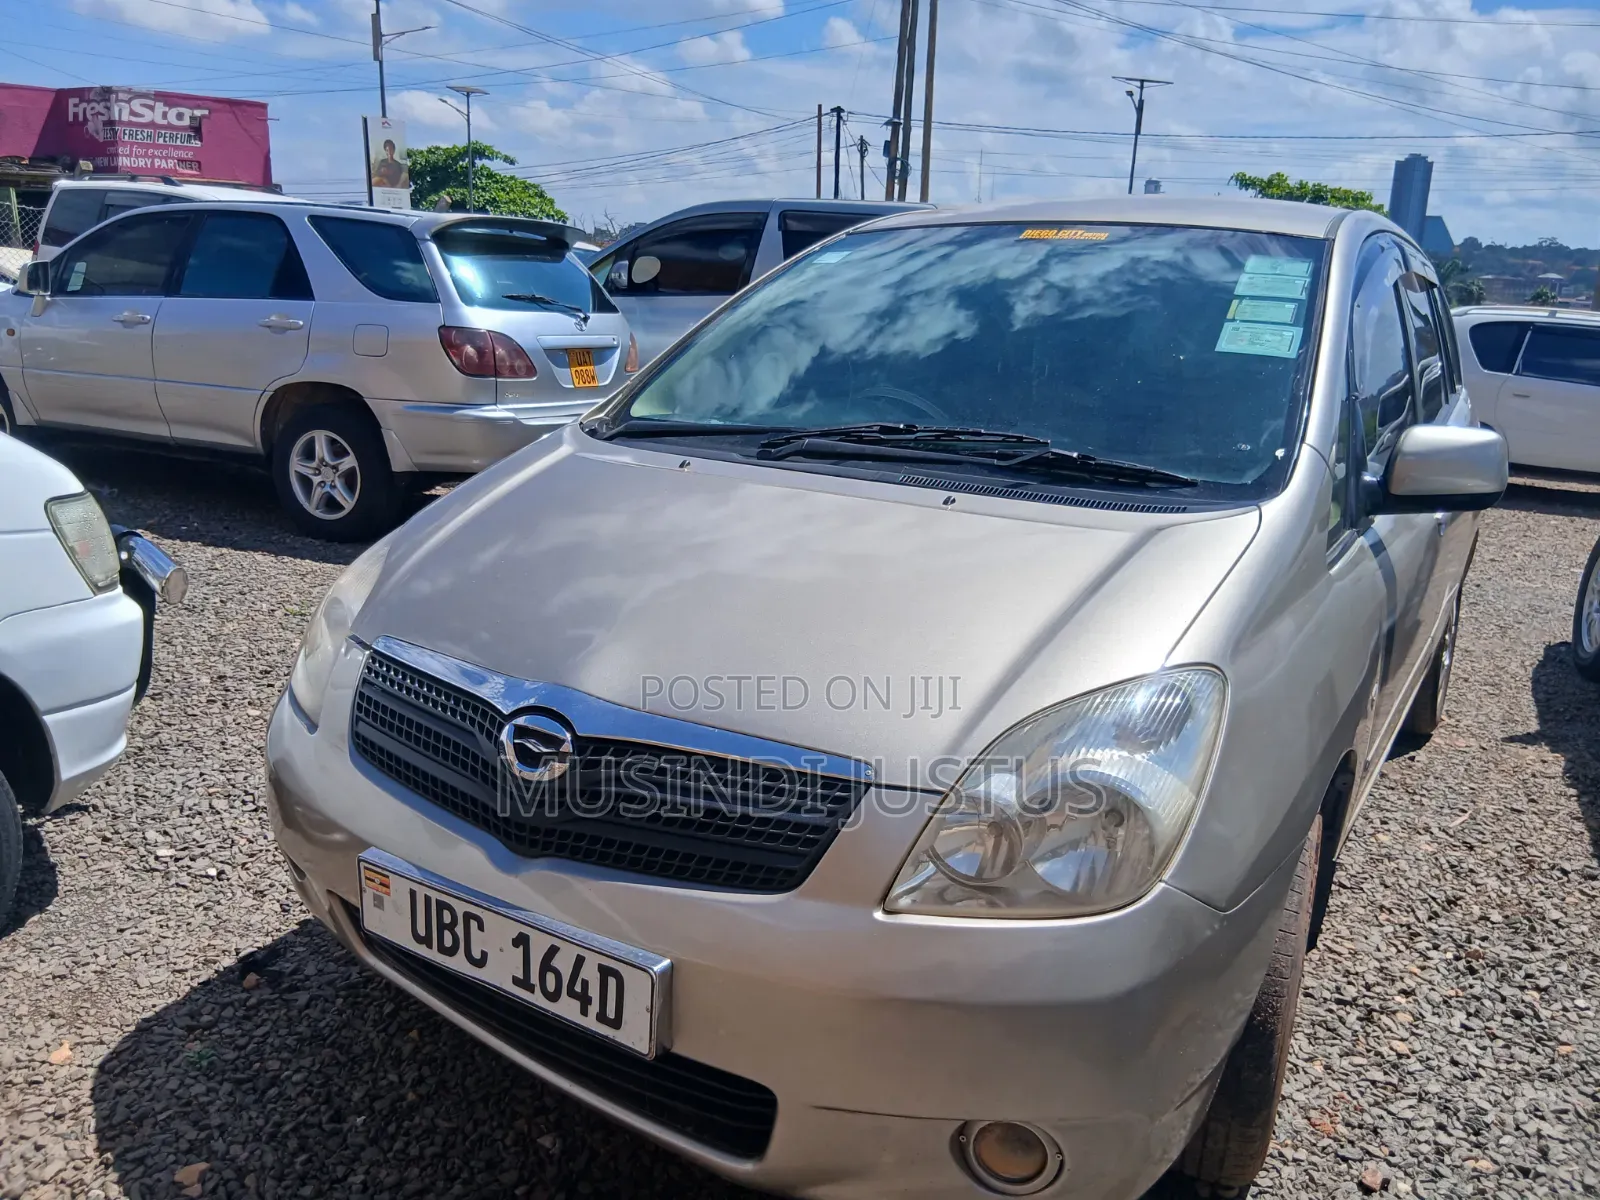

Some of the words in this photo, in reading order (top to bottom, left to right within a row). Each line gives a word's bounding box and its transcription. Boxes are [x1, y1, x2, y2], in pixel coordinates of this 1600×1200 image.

[122, 128, 153, 142] FRESH
[132, 145, 147, 157] for
[148, 147, 194, 158] excellence
[154, 159, 200, 171] PARTNER
[574, 369, 597, 385] 988W
[409, 887, 488, 969] UBC
[511, 931, 626, 1031] 164D
